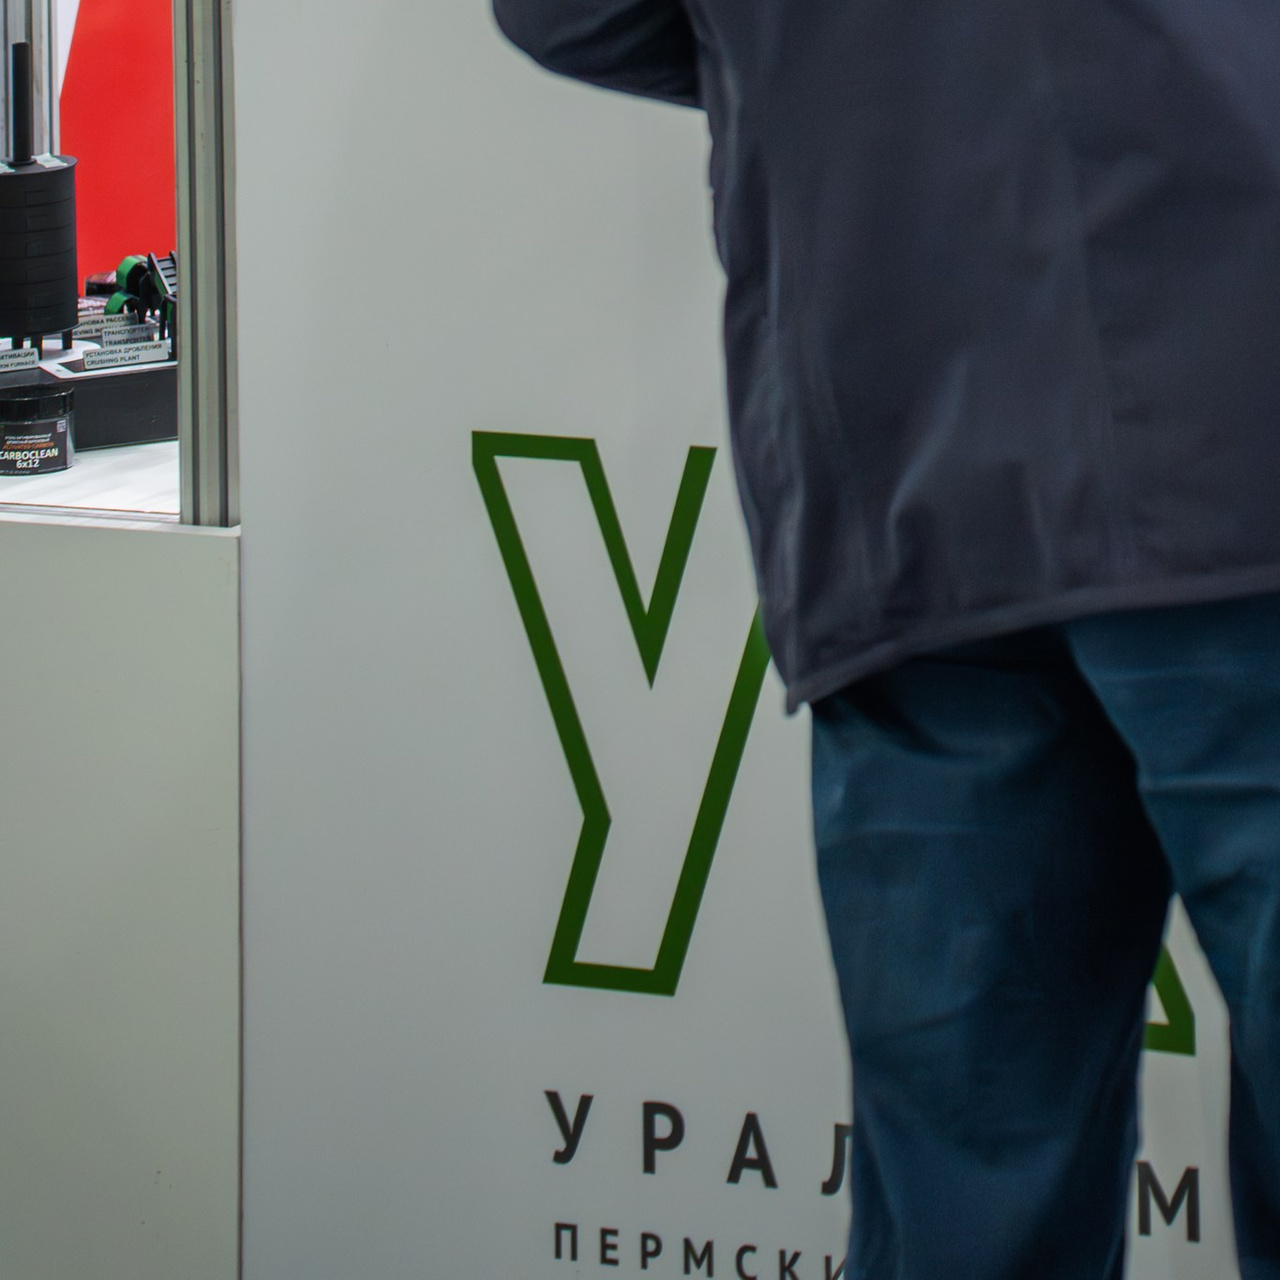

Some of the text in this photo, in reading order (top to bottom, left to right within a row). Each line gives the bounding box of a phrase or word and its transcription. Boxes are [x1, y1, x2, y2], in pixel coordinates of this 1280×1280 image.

[85, 344, 162, 358] УСТАНОВКА ДРОБЛЕНИЯ
[86, 357, 118, 366] CRUSHING
[16, 458, 40, 468] 6x12
